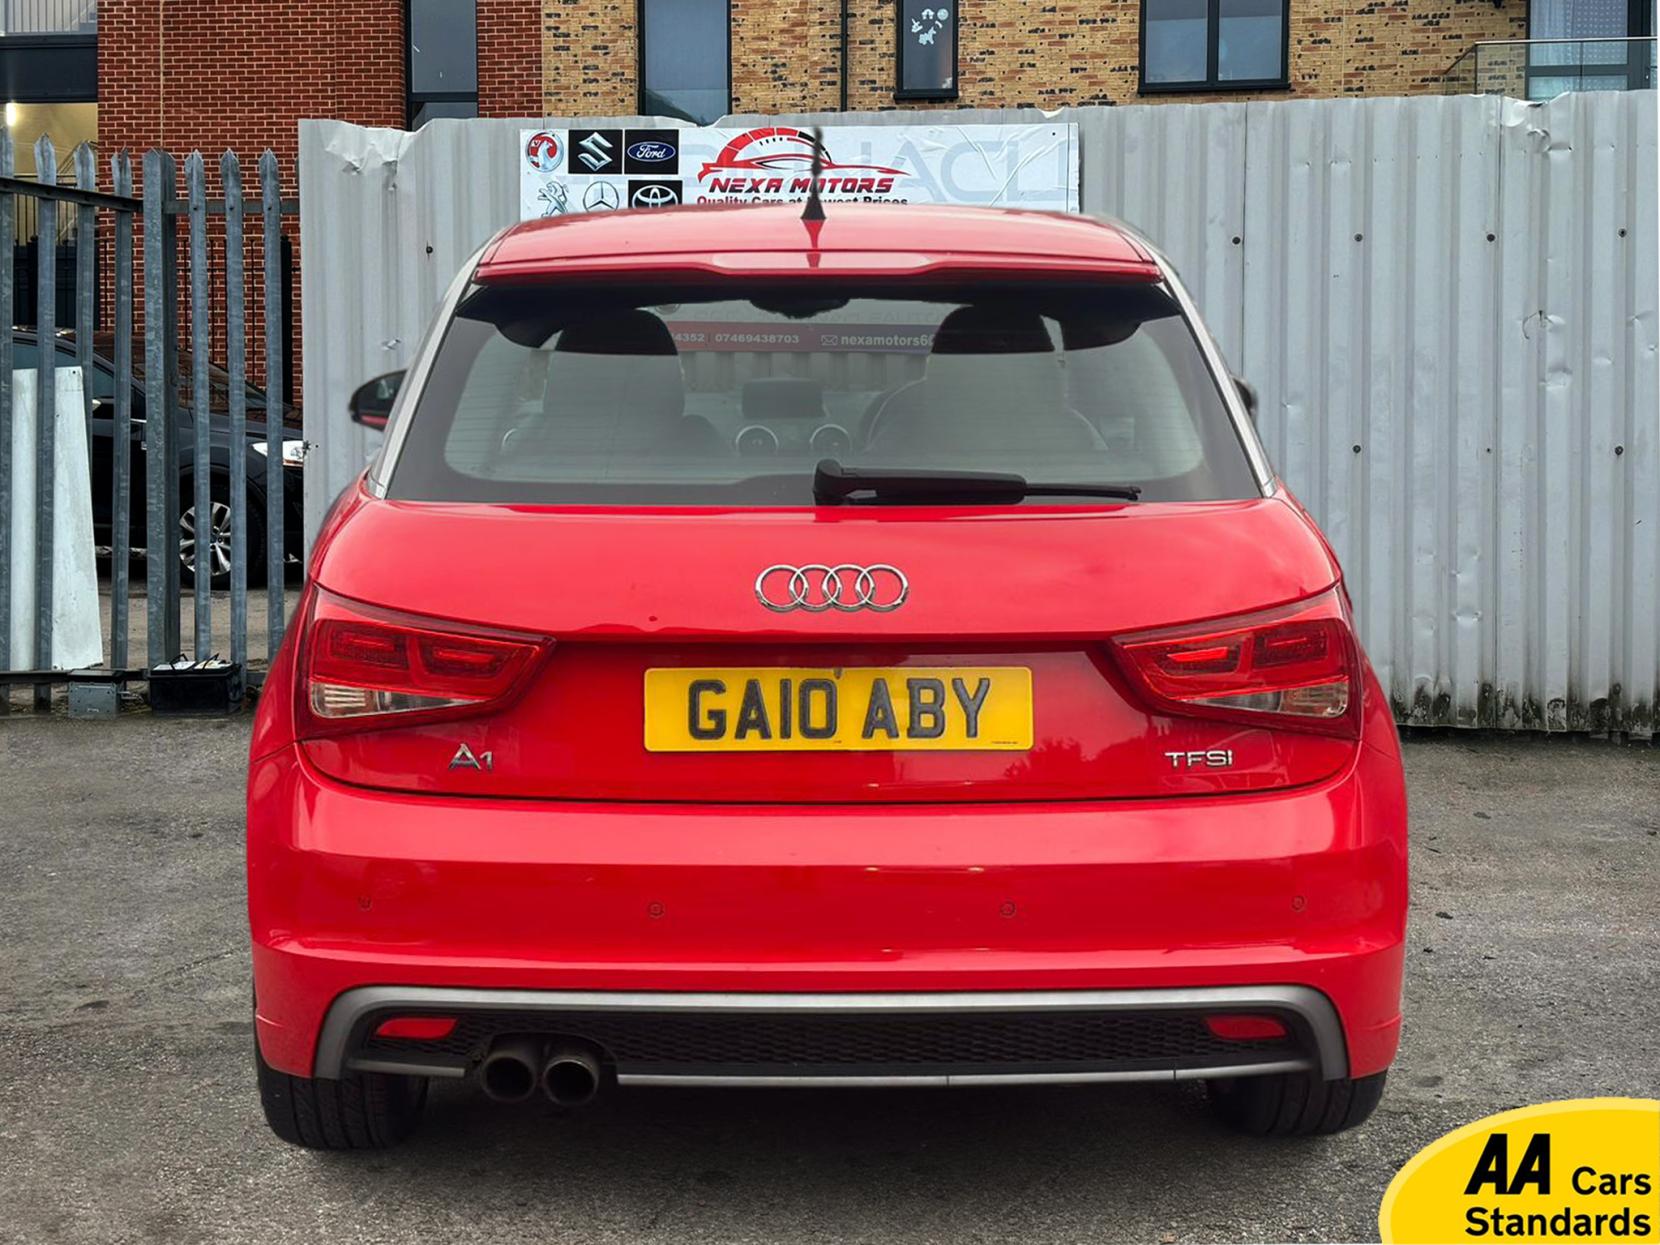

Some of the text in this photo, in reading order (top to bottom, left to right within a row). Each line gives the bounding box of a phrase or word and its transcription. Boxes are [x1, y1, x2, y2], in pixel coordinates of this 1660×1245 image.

[637, 144, 666, 159] Ford
[709, 177, 783, 193] NEXA
[861, 678, 991, 740] ABY
[448, 743, 493, 770] A1
[1164, 750, 1233, 767] TFSI
